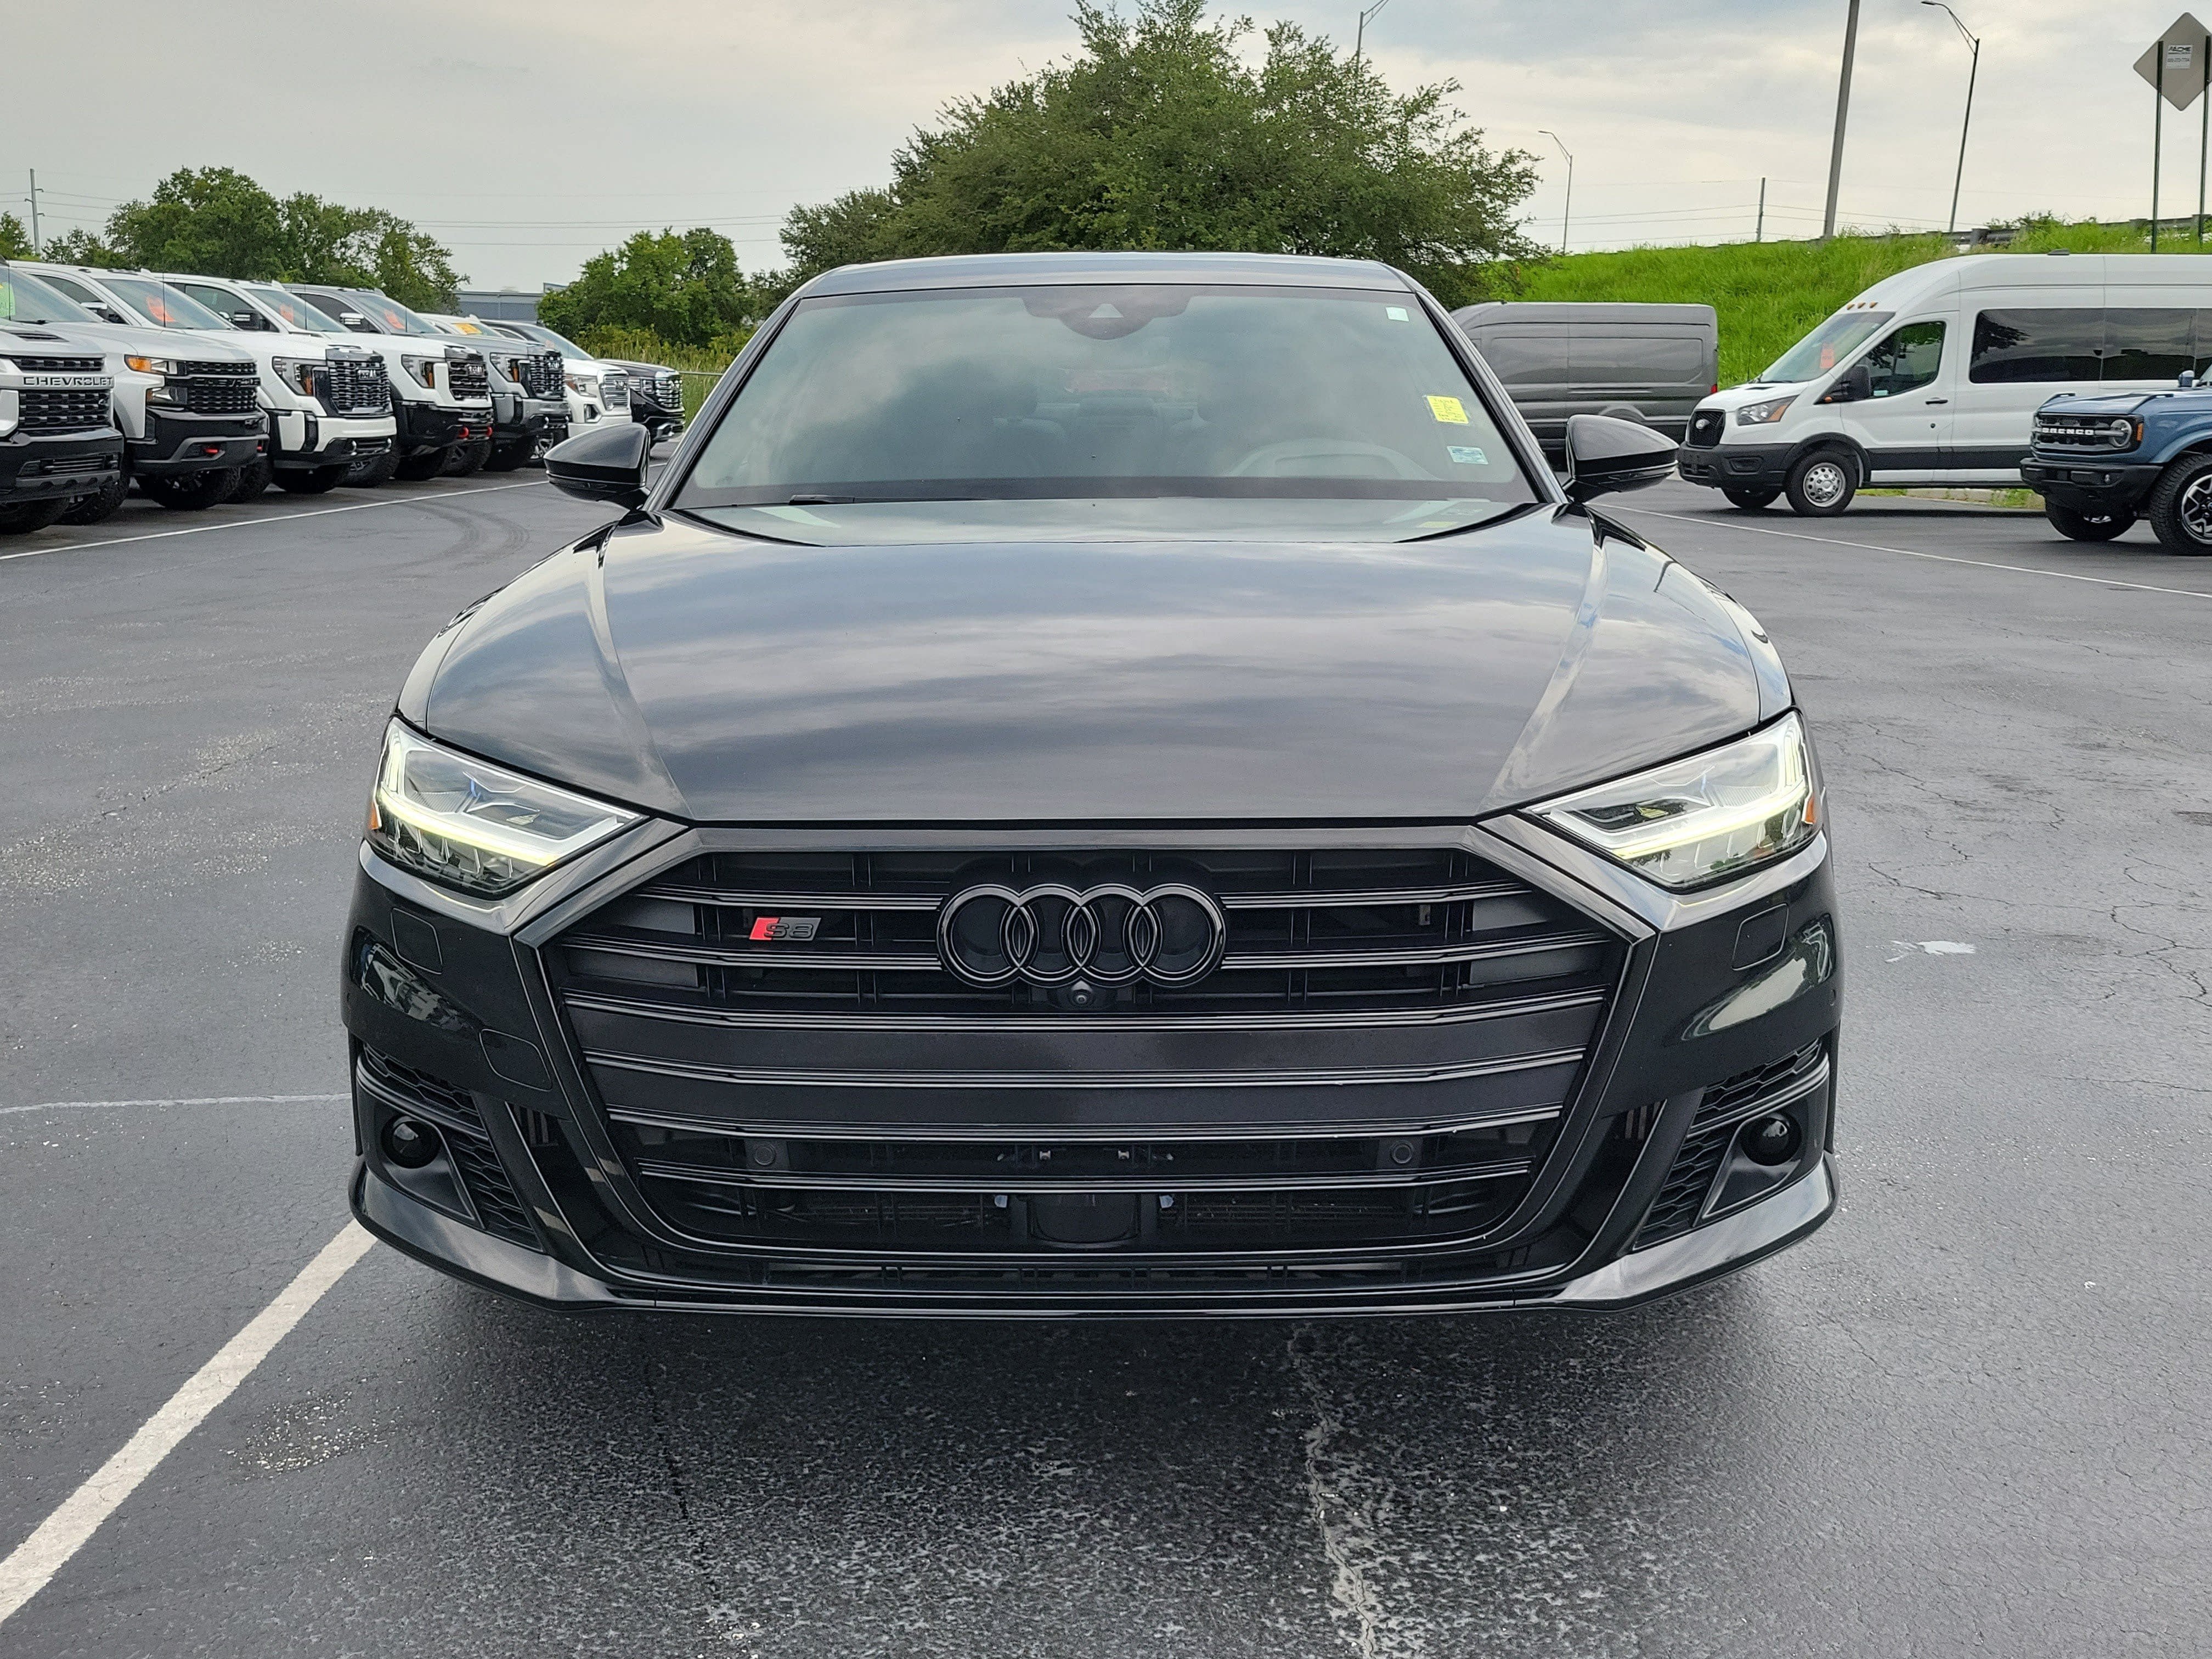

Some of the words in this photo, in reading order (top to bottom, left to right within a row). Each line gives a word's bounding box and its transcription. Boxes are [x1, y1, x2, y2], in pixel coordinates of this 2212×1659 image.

[23, 376, 112, 386] CHEVROLET
[2042, 427, 2094, 436] BRONCO
[764, 922, 814, 939] S8
